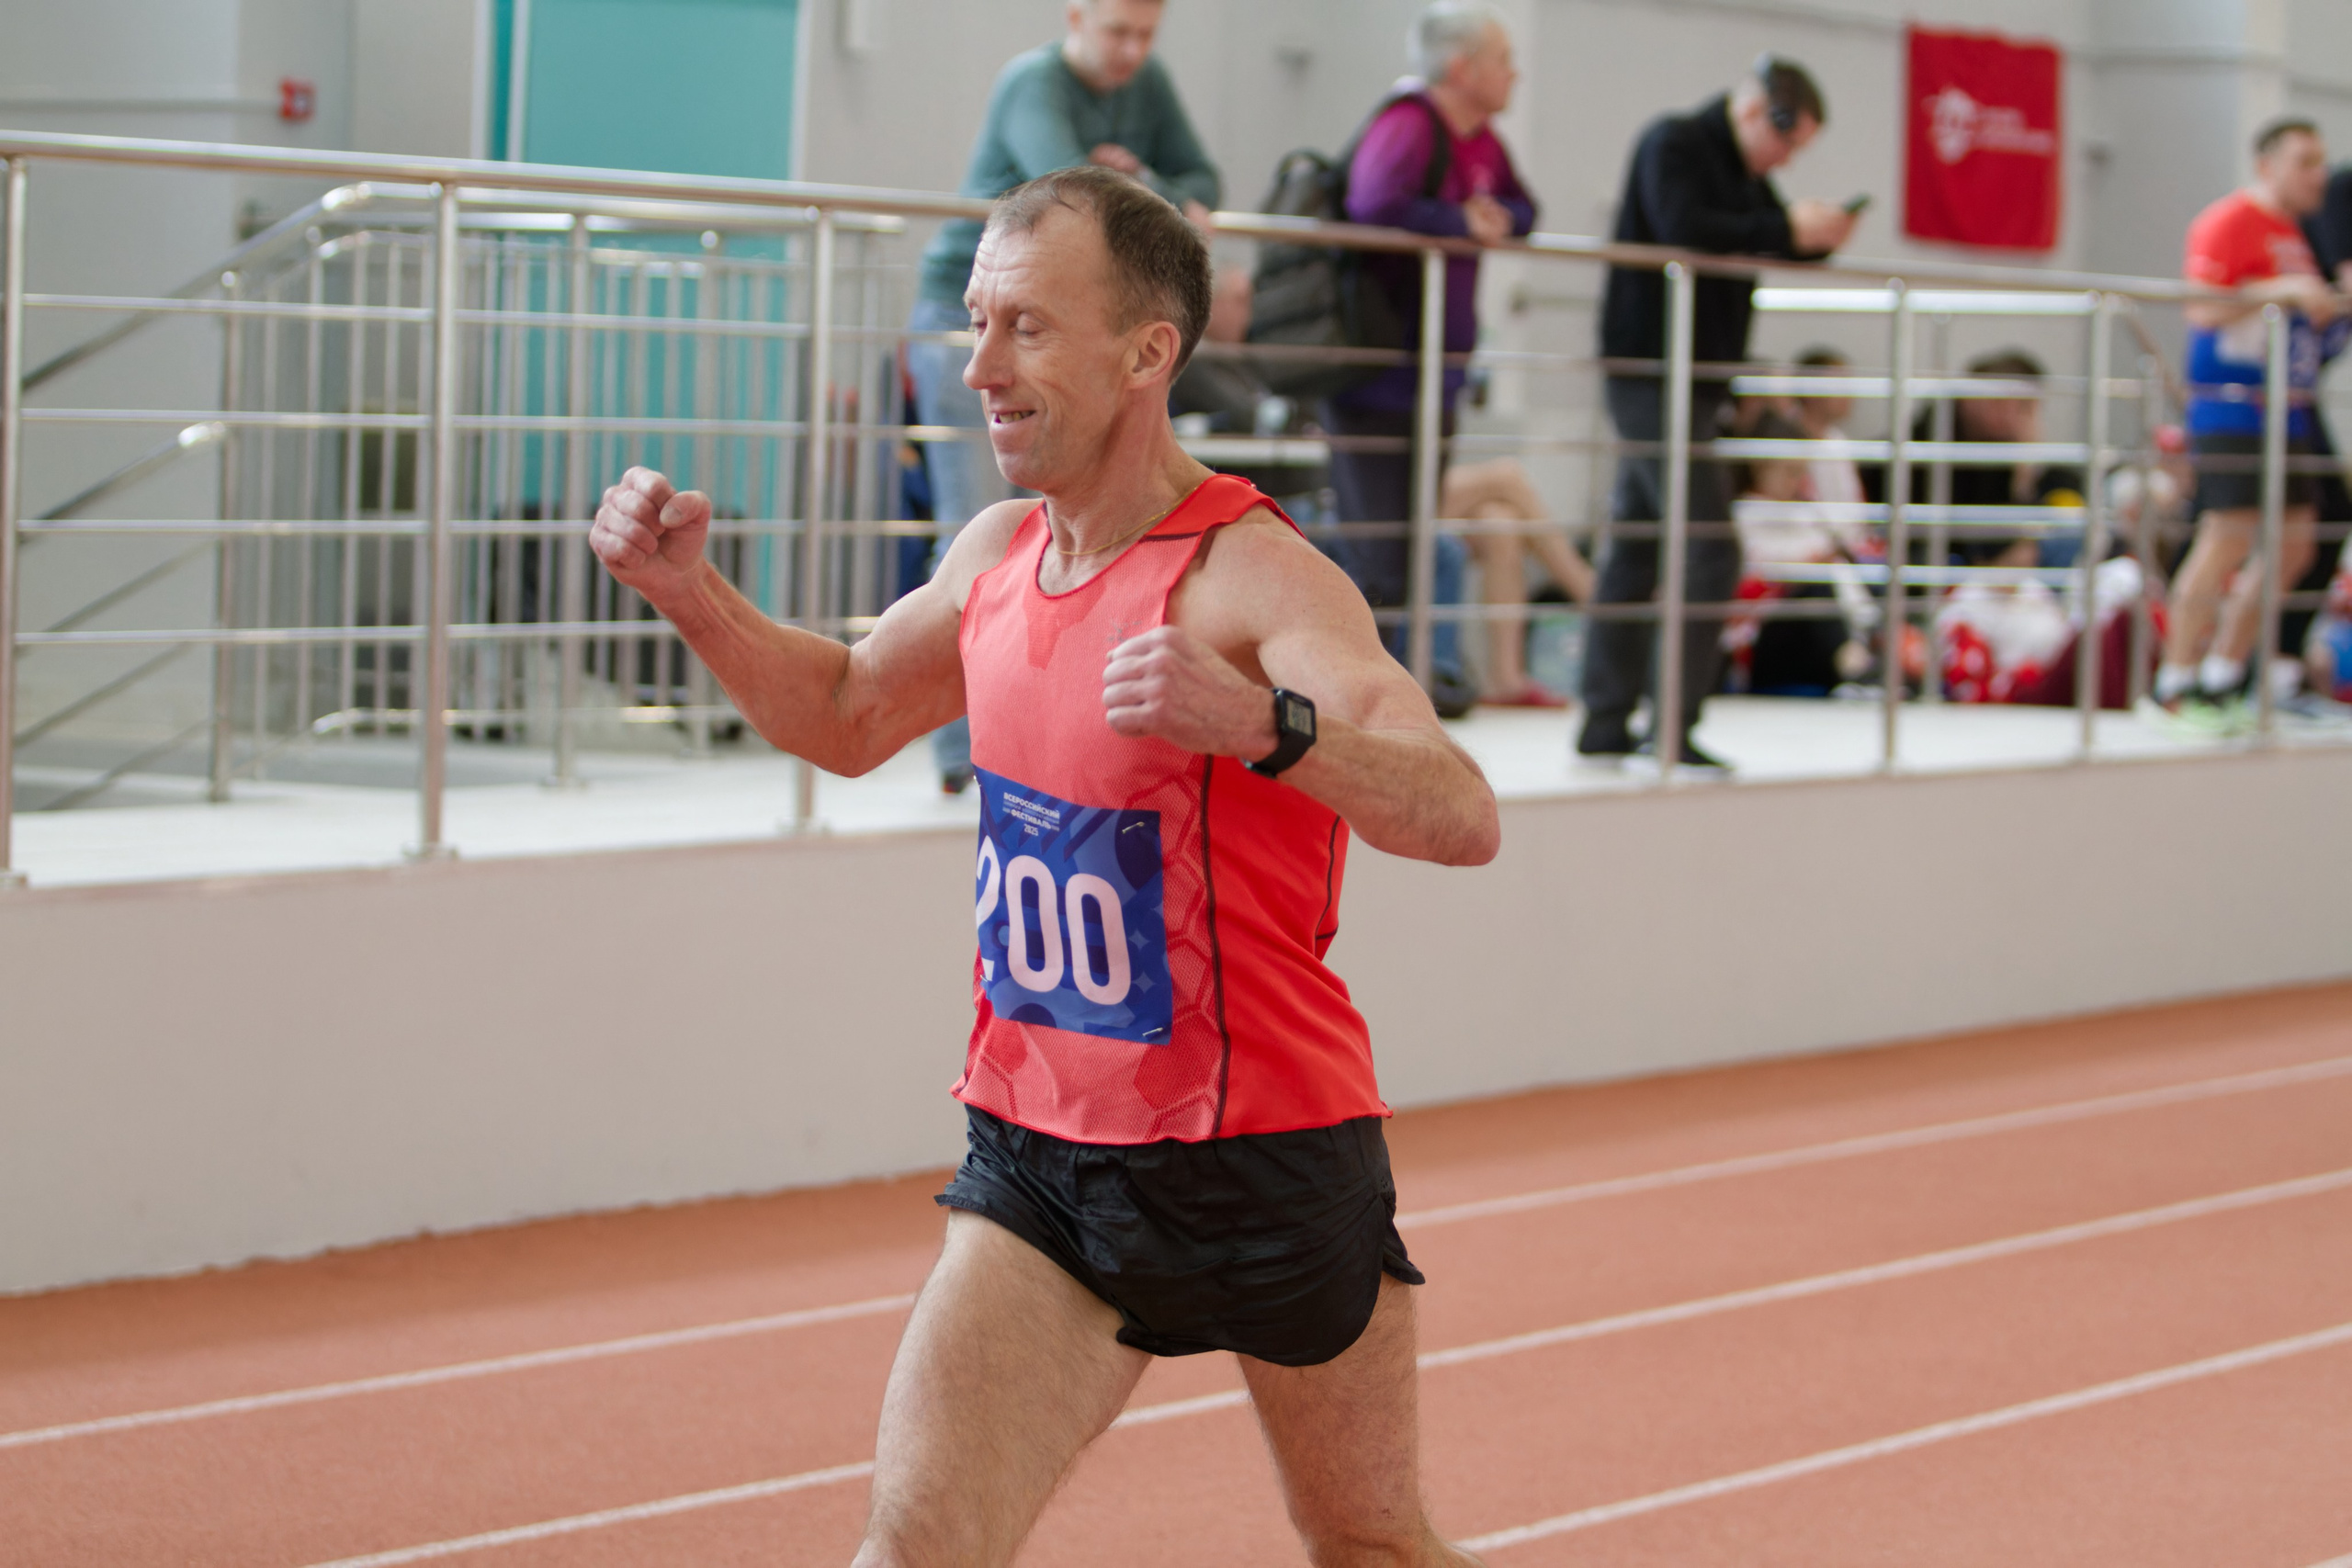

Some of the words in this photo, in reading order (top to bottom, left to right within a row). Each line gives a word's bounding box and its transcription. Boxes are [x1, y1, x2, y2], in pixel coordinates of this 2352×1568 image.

[1003, 792, 1060, 819] ВСЕРОССИЙСКИЙ
[1011, 808, 1052, 829] ФЕСТИВАЛЬ
[1023, 823, 1039, 837] 2025
